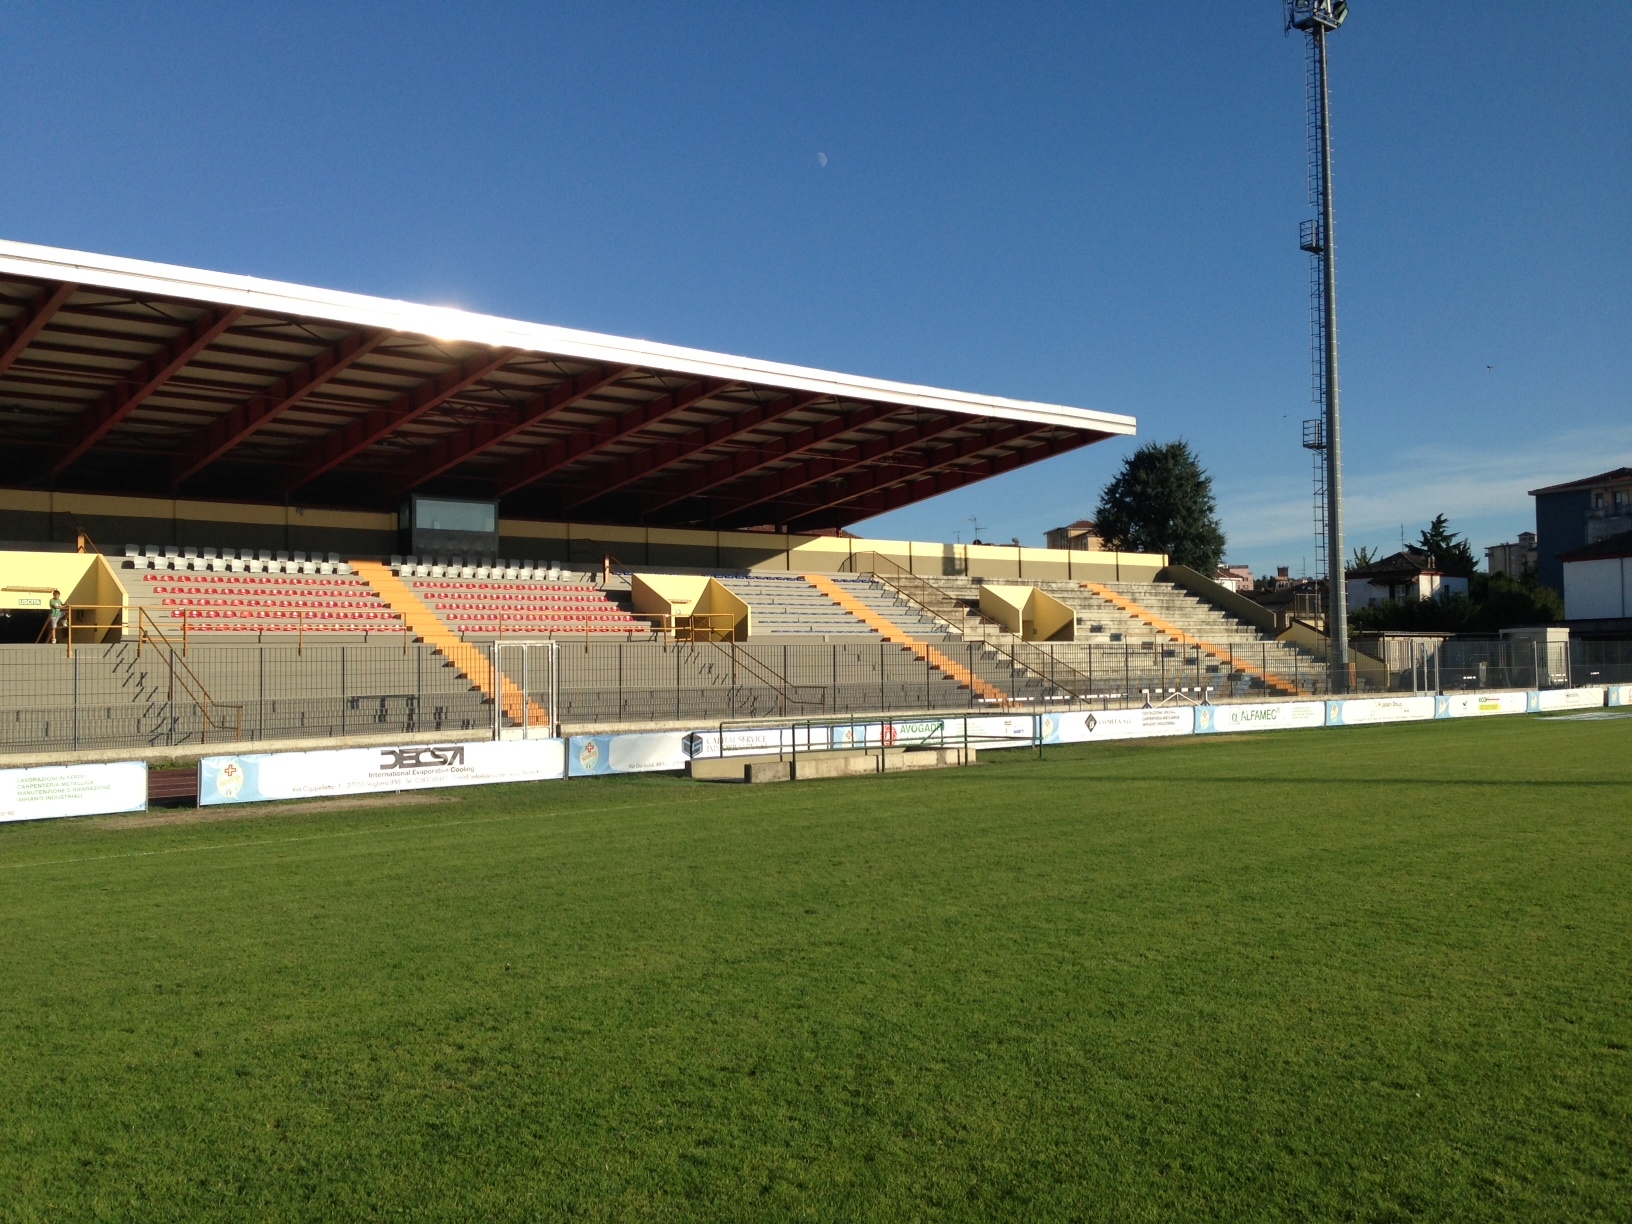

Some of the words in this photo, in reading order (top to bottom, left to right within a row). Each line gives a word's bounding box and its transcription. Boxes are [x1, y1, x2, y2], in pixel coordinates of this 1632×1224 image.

[706, 736, 736, 745] CAPTAL
[738, 735, 767, 743] SERVICE
[380, 746, 465, 770] DECSA
[368, 769, 411, 778] International
[412, 768, 449, 776] Evaporative
[450, 766, 475, 774] Cooling
[17, 788, 65, 796] MANUTENZIONE
[72, 784, 111, 792] RIPARAZIONE
[45, 793, 83, 801] INDUSTRIALI
